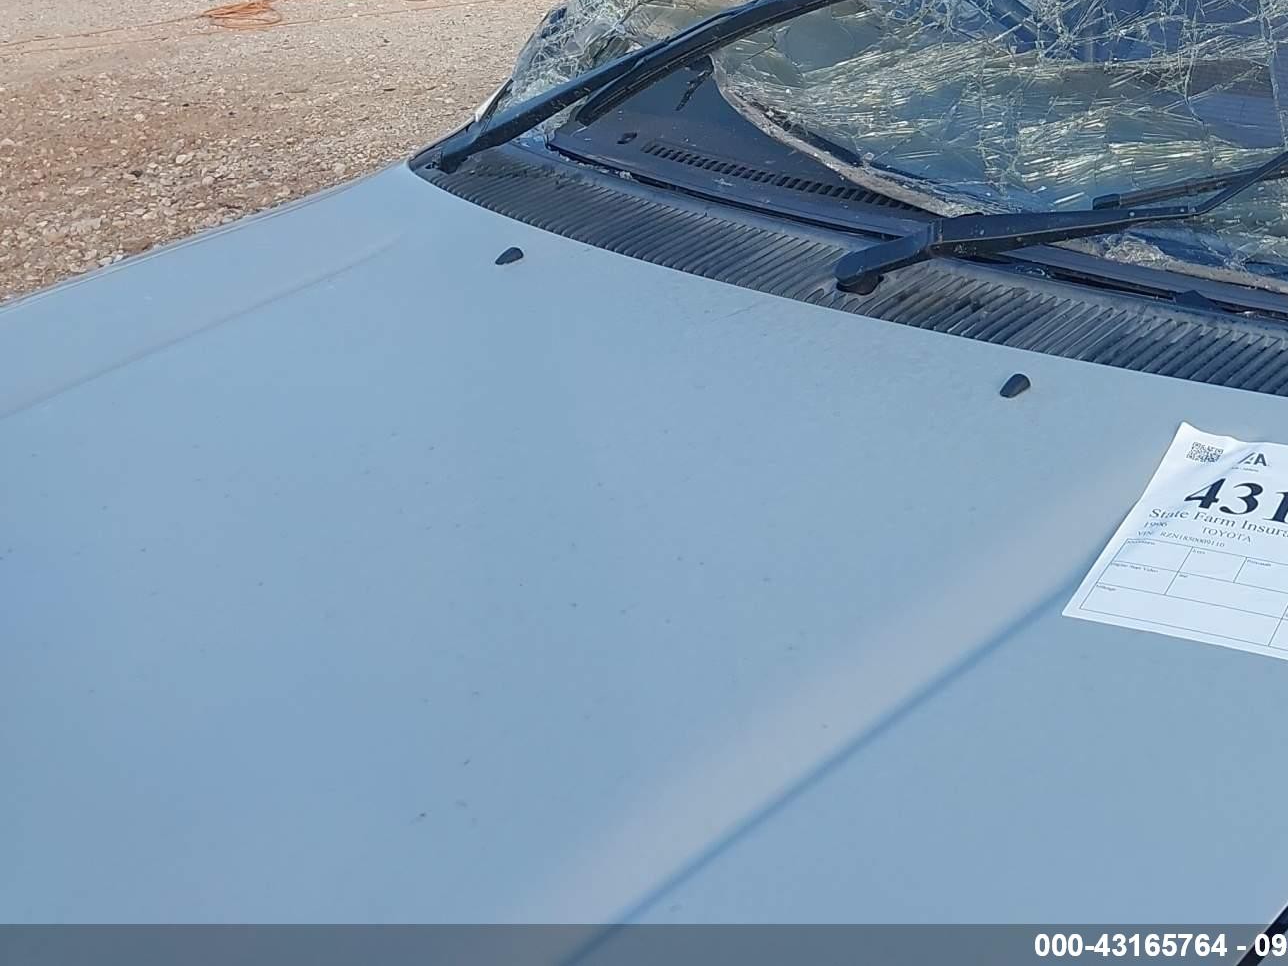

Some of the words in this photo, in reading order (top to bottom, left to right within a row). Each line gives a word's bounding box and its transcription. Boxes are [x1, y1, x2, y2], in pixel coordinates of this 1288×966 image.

[1149, 508, 1190, 519] State
[1193, 511, 1236, 528] Farm
[1201, 525, 1252, 543] TOYOTA
